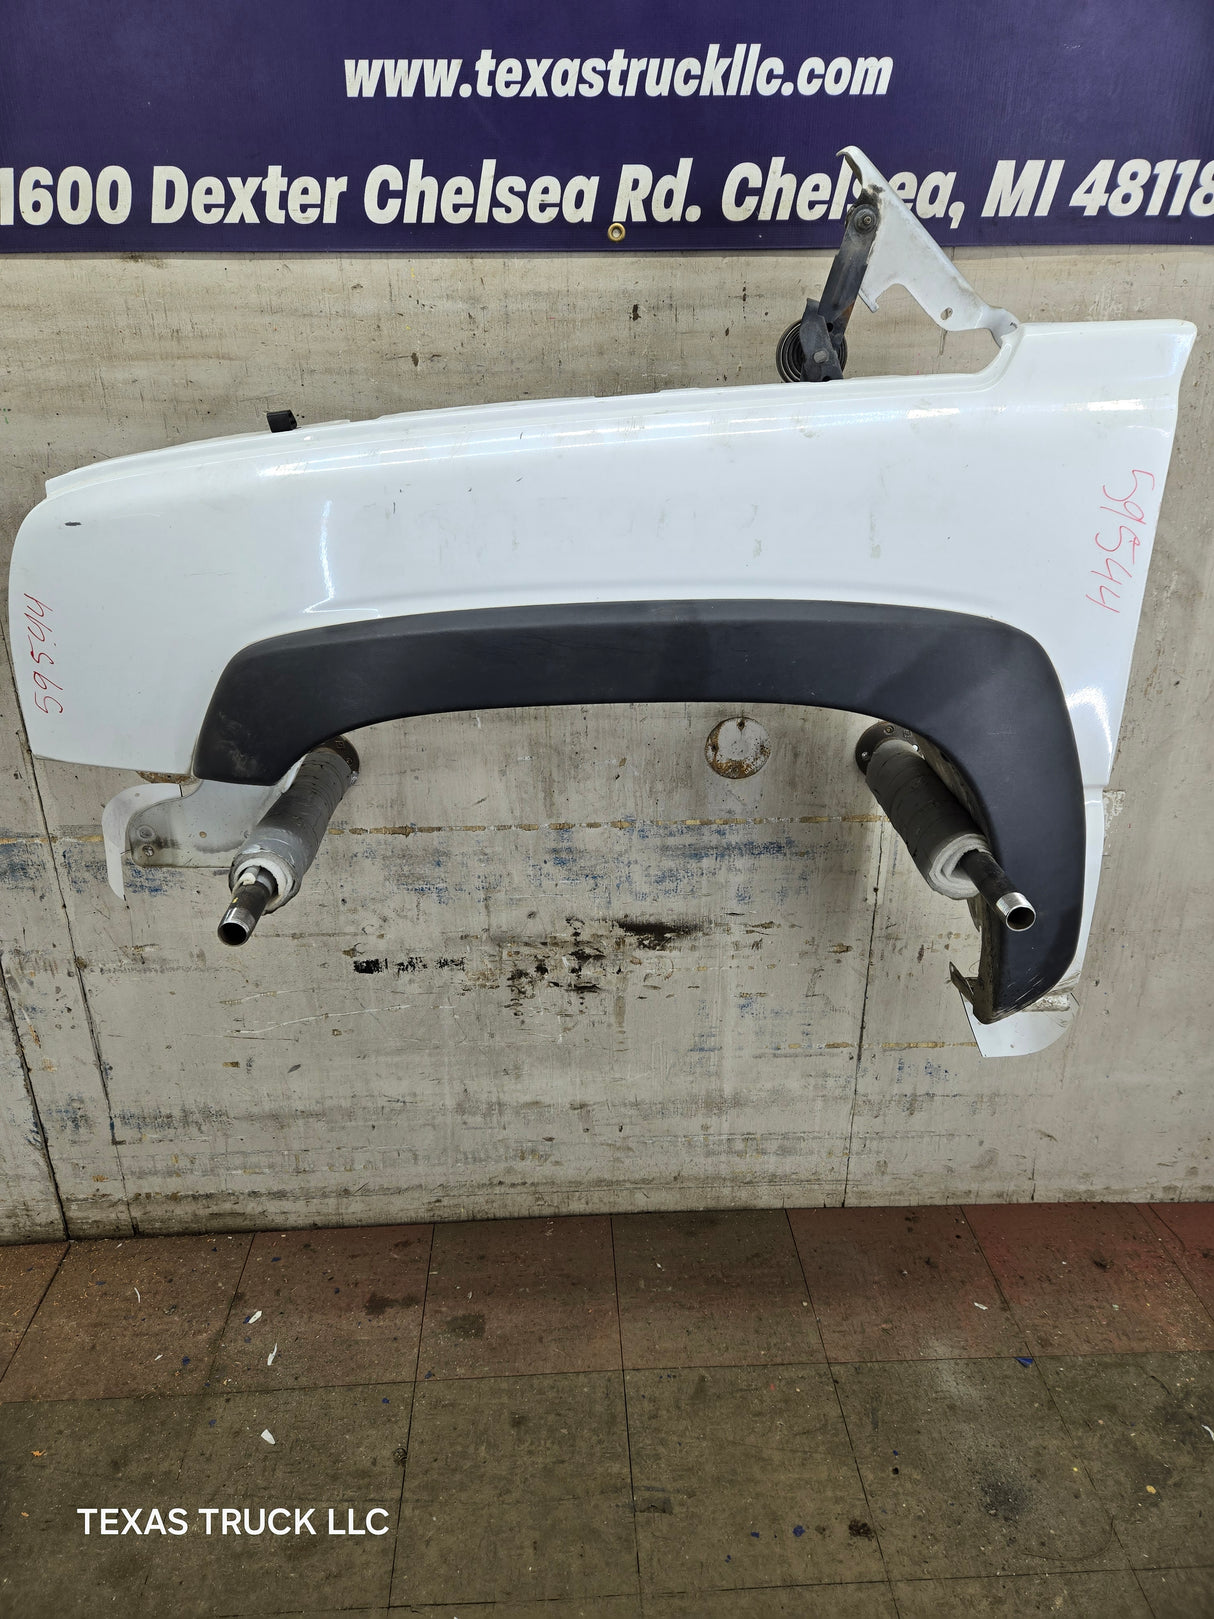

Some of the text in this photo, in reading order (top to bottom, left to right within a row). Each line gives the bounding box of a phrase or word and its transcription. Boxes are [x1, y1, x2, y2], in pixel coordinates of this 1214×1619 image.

[344, 43, 893, 97] www.texastruckllc.com
[151, 165, 347, 224] Dexter
[364, 159, 600, 224] Chelsea
[612, 157, 701, 222] Rd.
[981, 160, 1065, 218] MI
[1069, 158, 1214, 217] 48118
[1085, 469, 1155, 613] 59544
